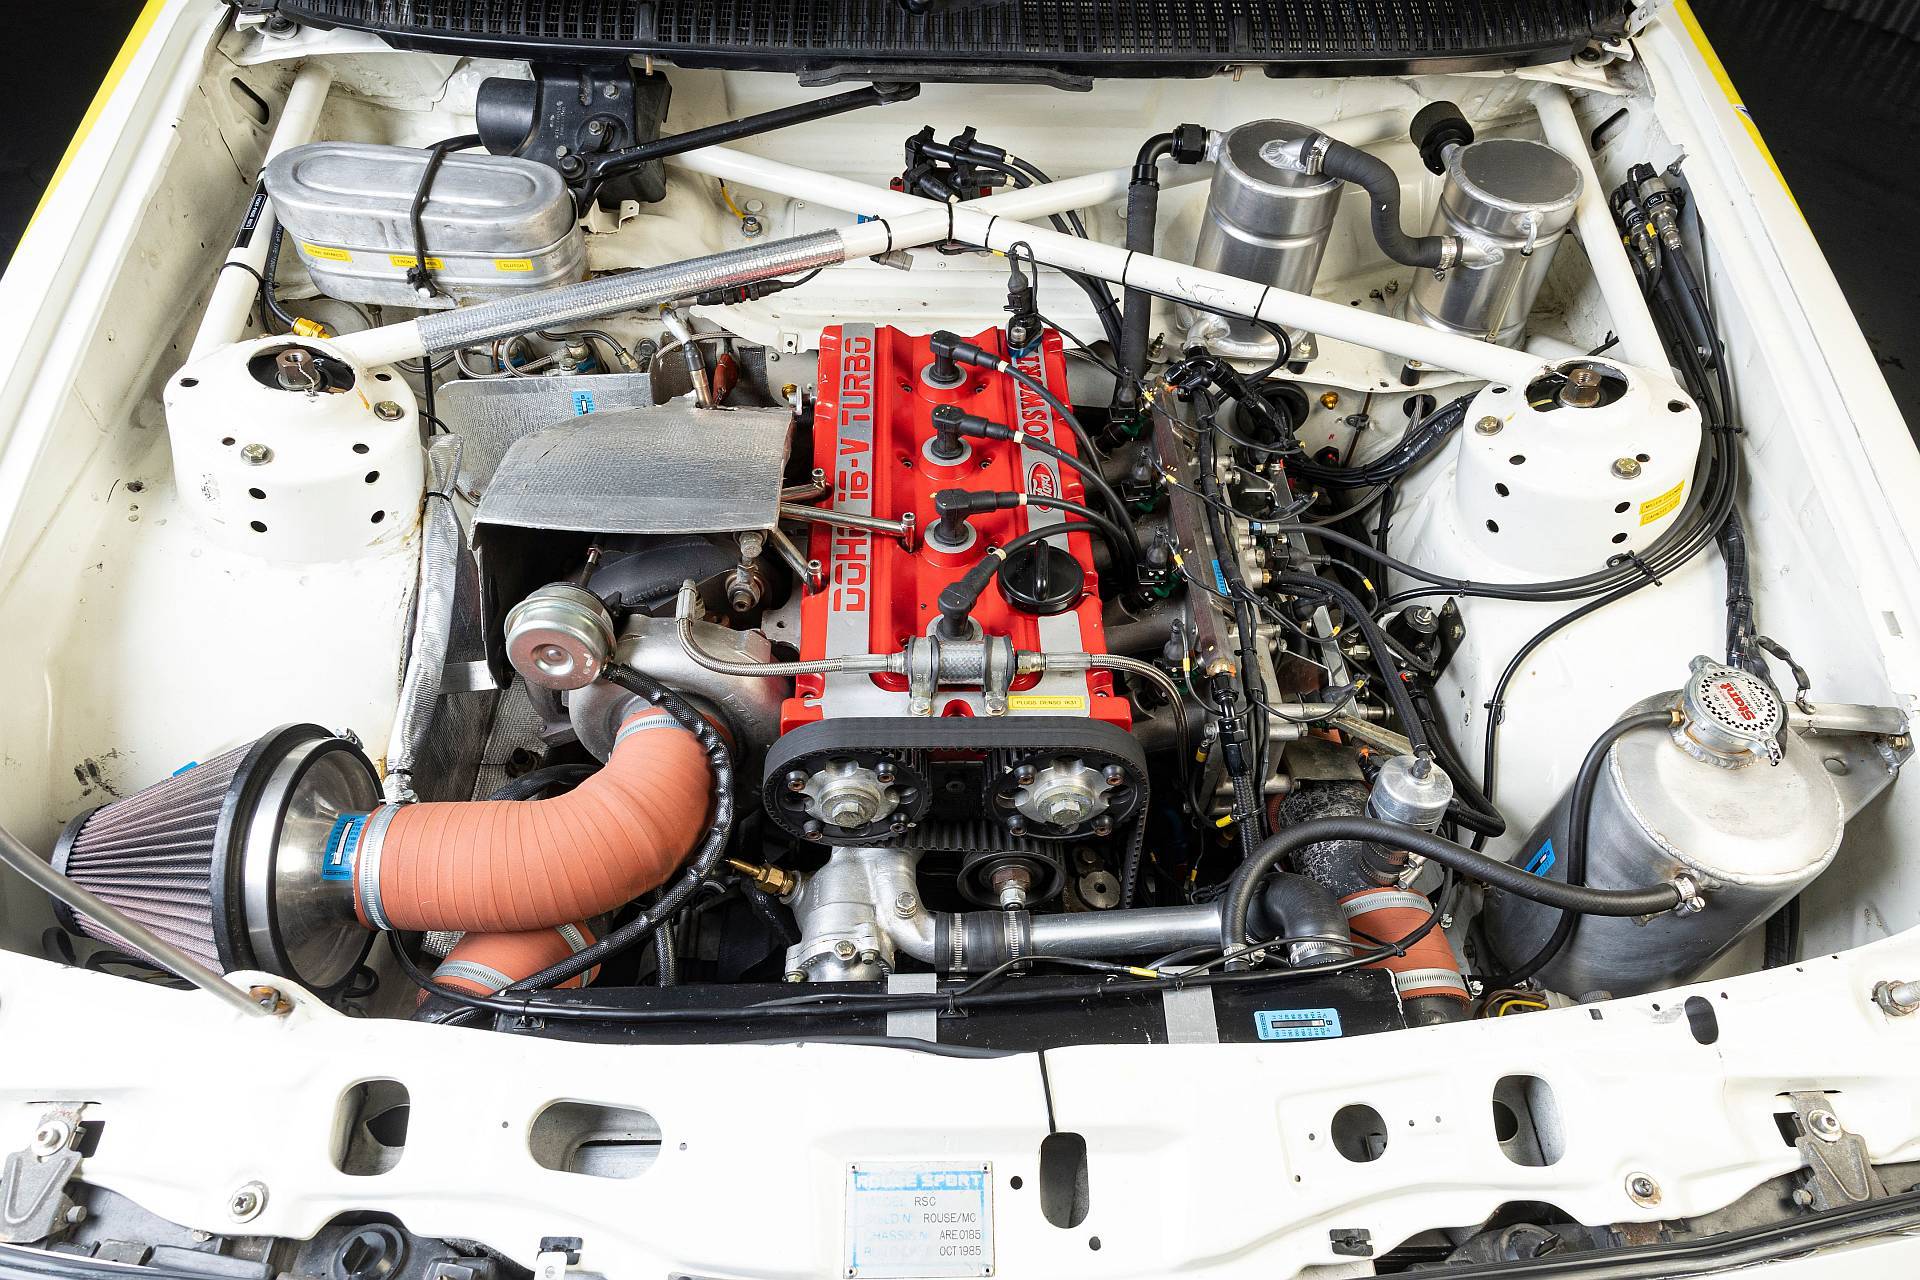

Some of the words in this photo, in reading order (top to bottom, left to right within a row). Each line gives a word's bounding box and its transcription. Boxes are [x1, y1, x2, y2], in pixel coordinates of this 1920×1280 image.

[841, 336, 872, 426] TURBO
[1015, 348, 1051, 450] OSWORT
[838, 438, 869, 502] 16-V
[1719, 682, 1757, 721] Stant
[922, 1173, 982, 1188] SPORT
[914, 1196, 937, 1207] RSC
[923, 1212, 977, 1224] ROUSE/MC
